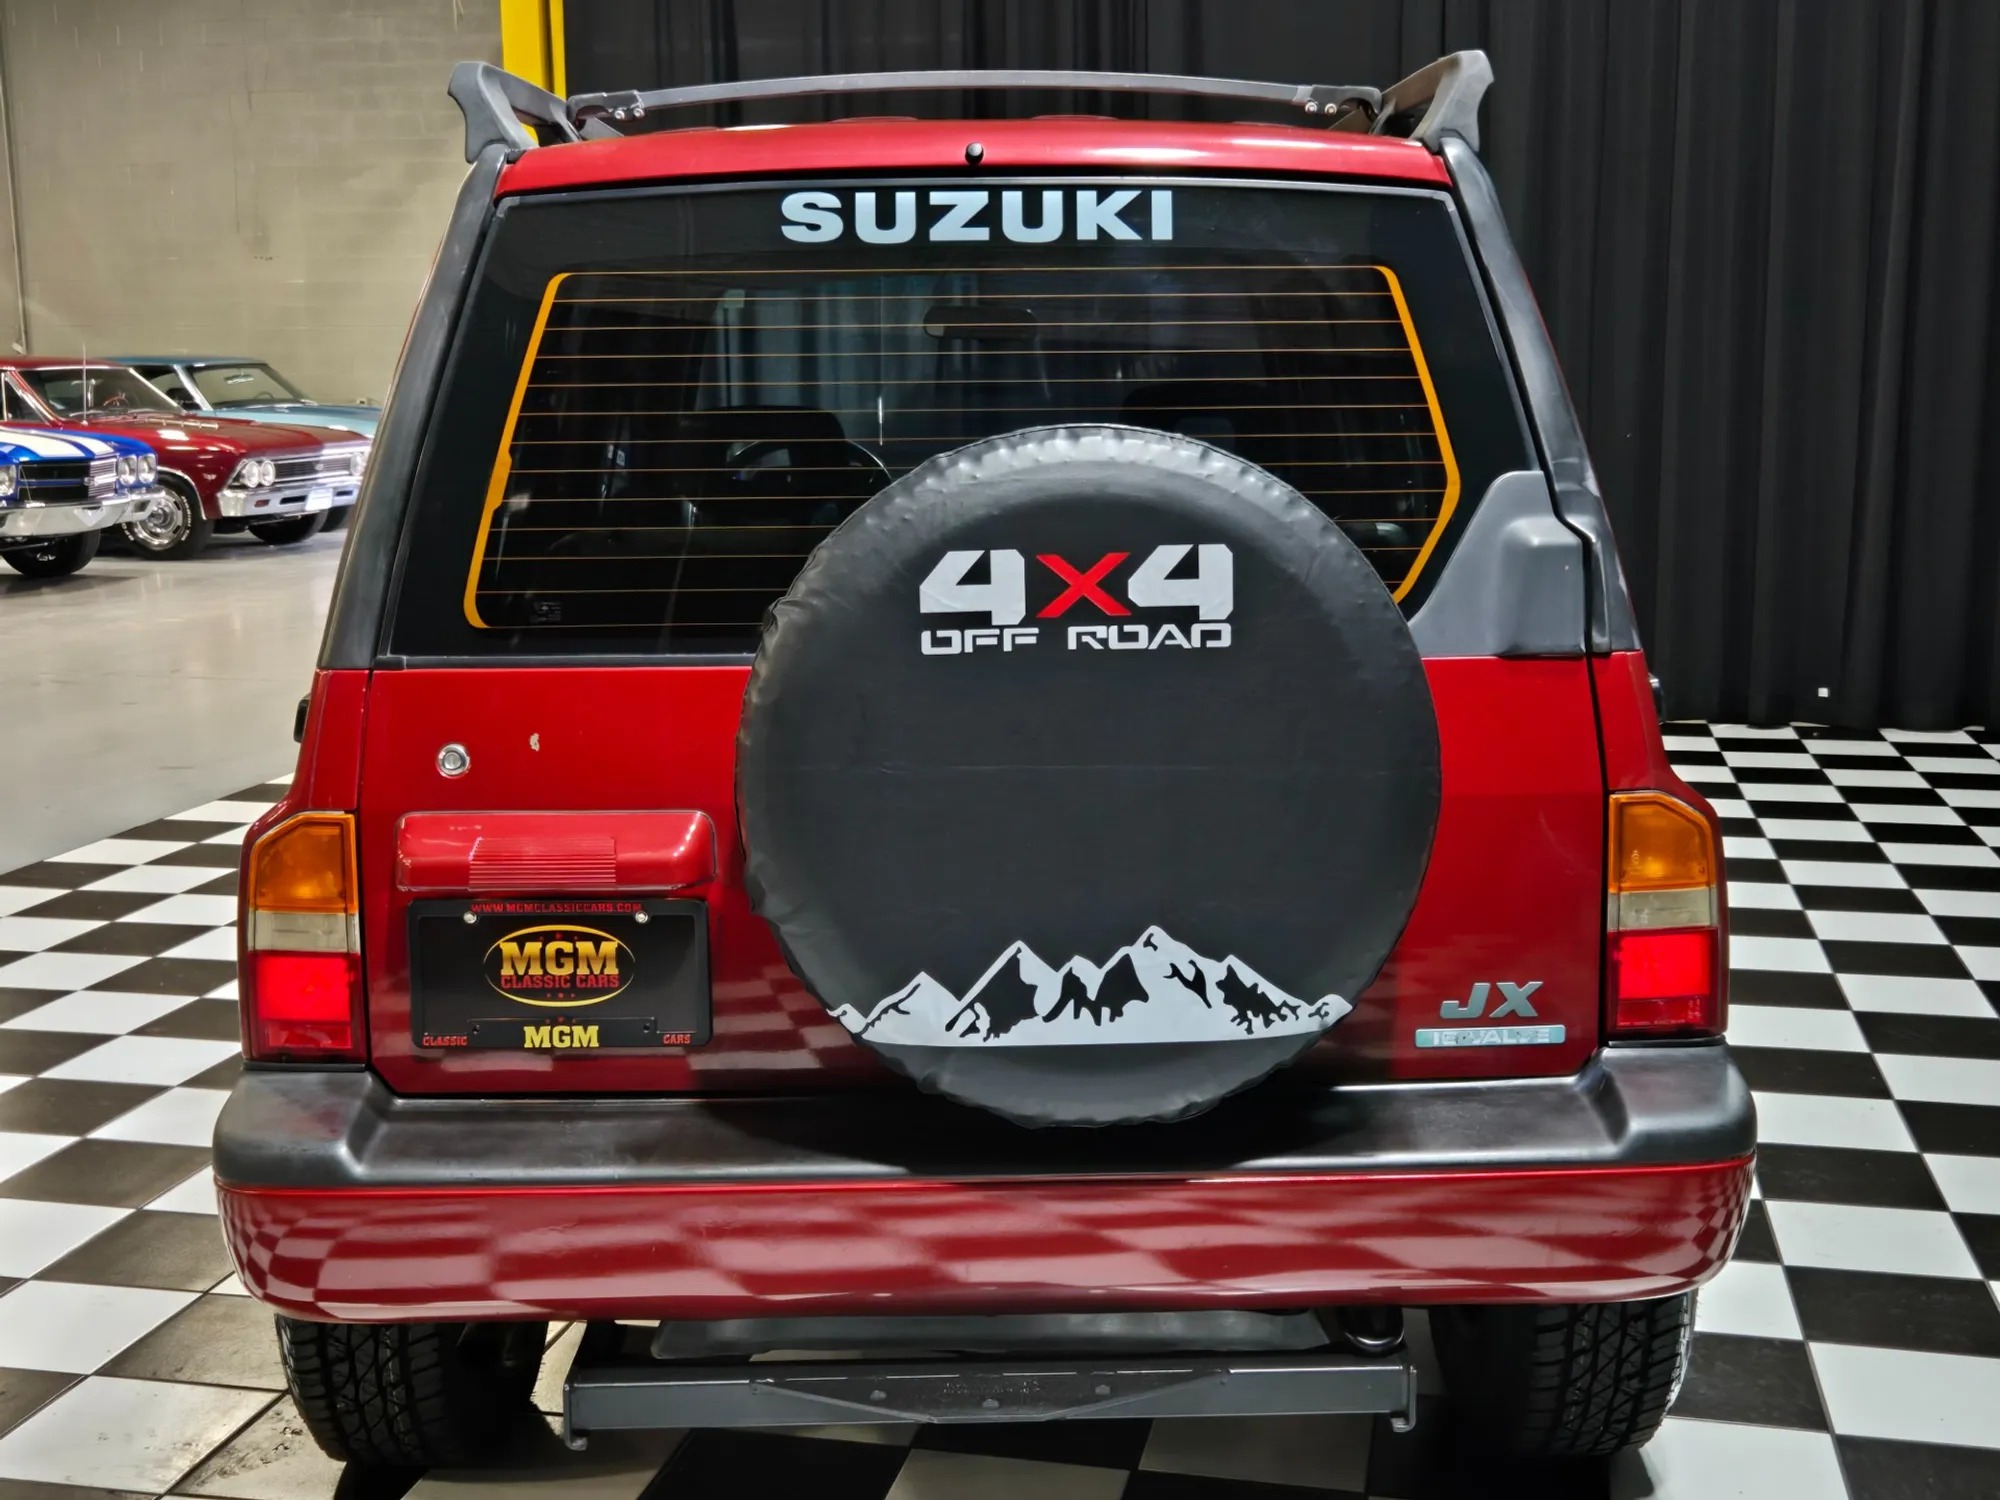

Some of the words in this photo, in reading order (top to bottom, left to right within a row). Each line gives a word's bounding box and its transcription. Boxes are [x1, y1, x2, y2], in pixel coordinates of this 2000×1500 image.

[780, 189, 1174, 244] SUZUKI
[920, 627, 1040, 656] OFF
[1067, 622, 1232, 651] ROAD
[499, 940, 619, 976] MGM
[500, 975, 572, 989] CLASSIC
[576, 974, 620, 989] CARS
[1439, 980, 1544, 1020] JX
[422, 1035, 468, 1047] CLASSIC
[523, 1025, 600, 1049] MGM
[662, 1034, 692, 1046] CARS
